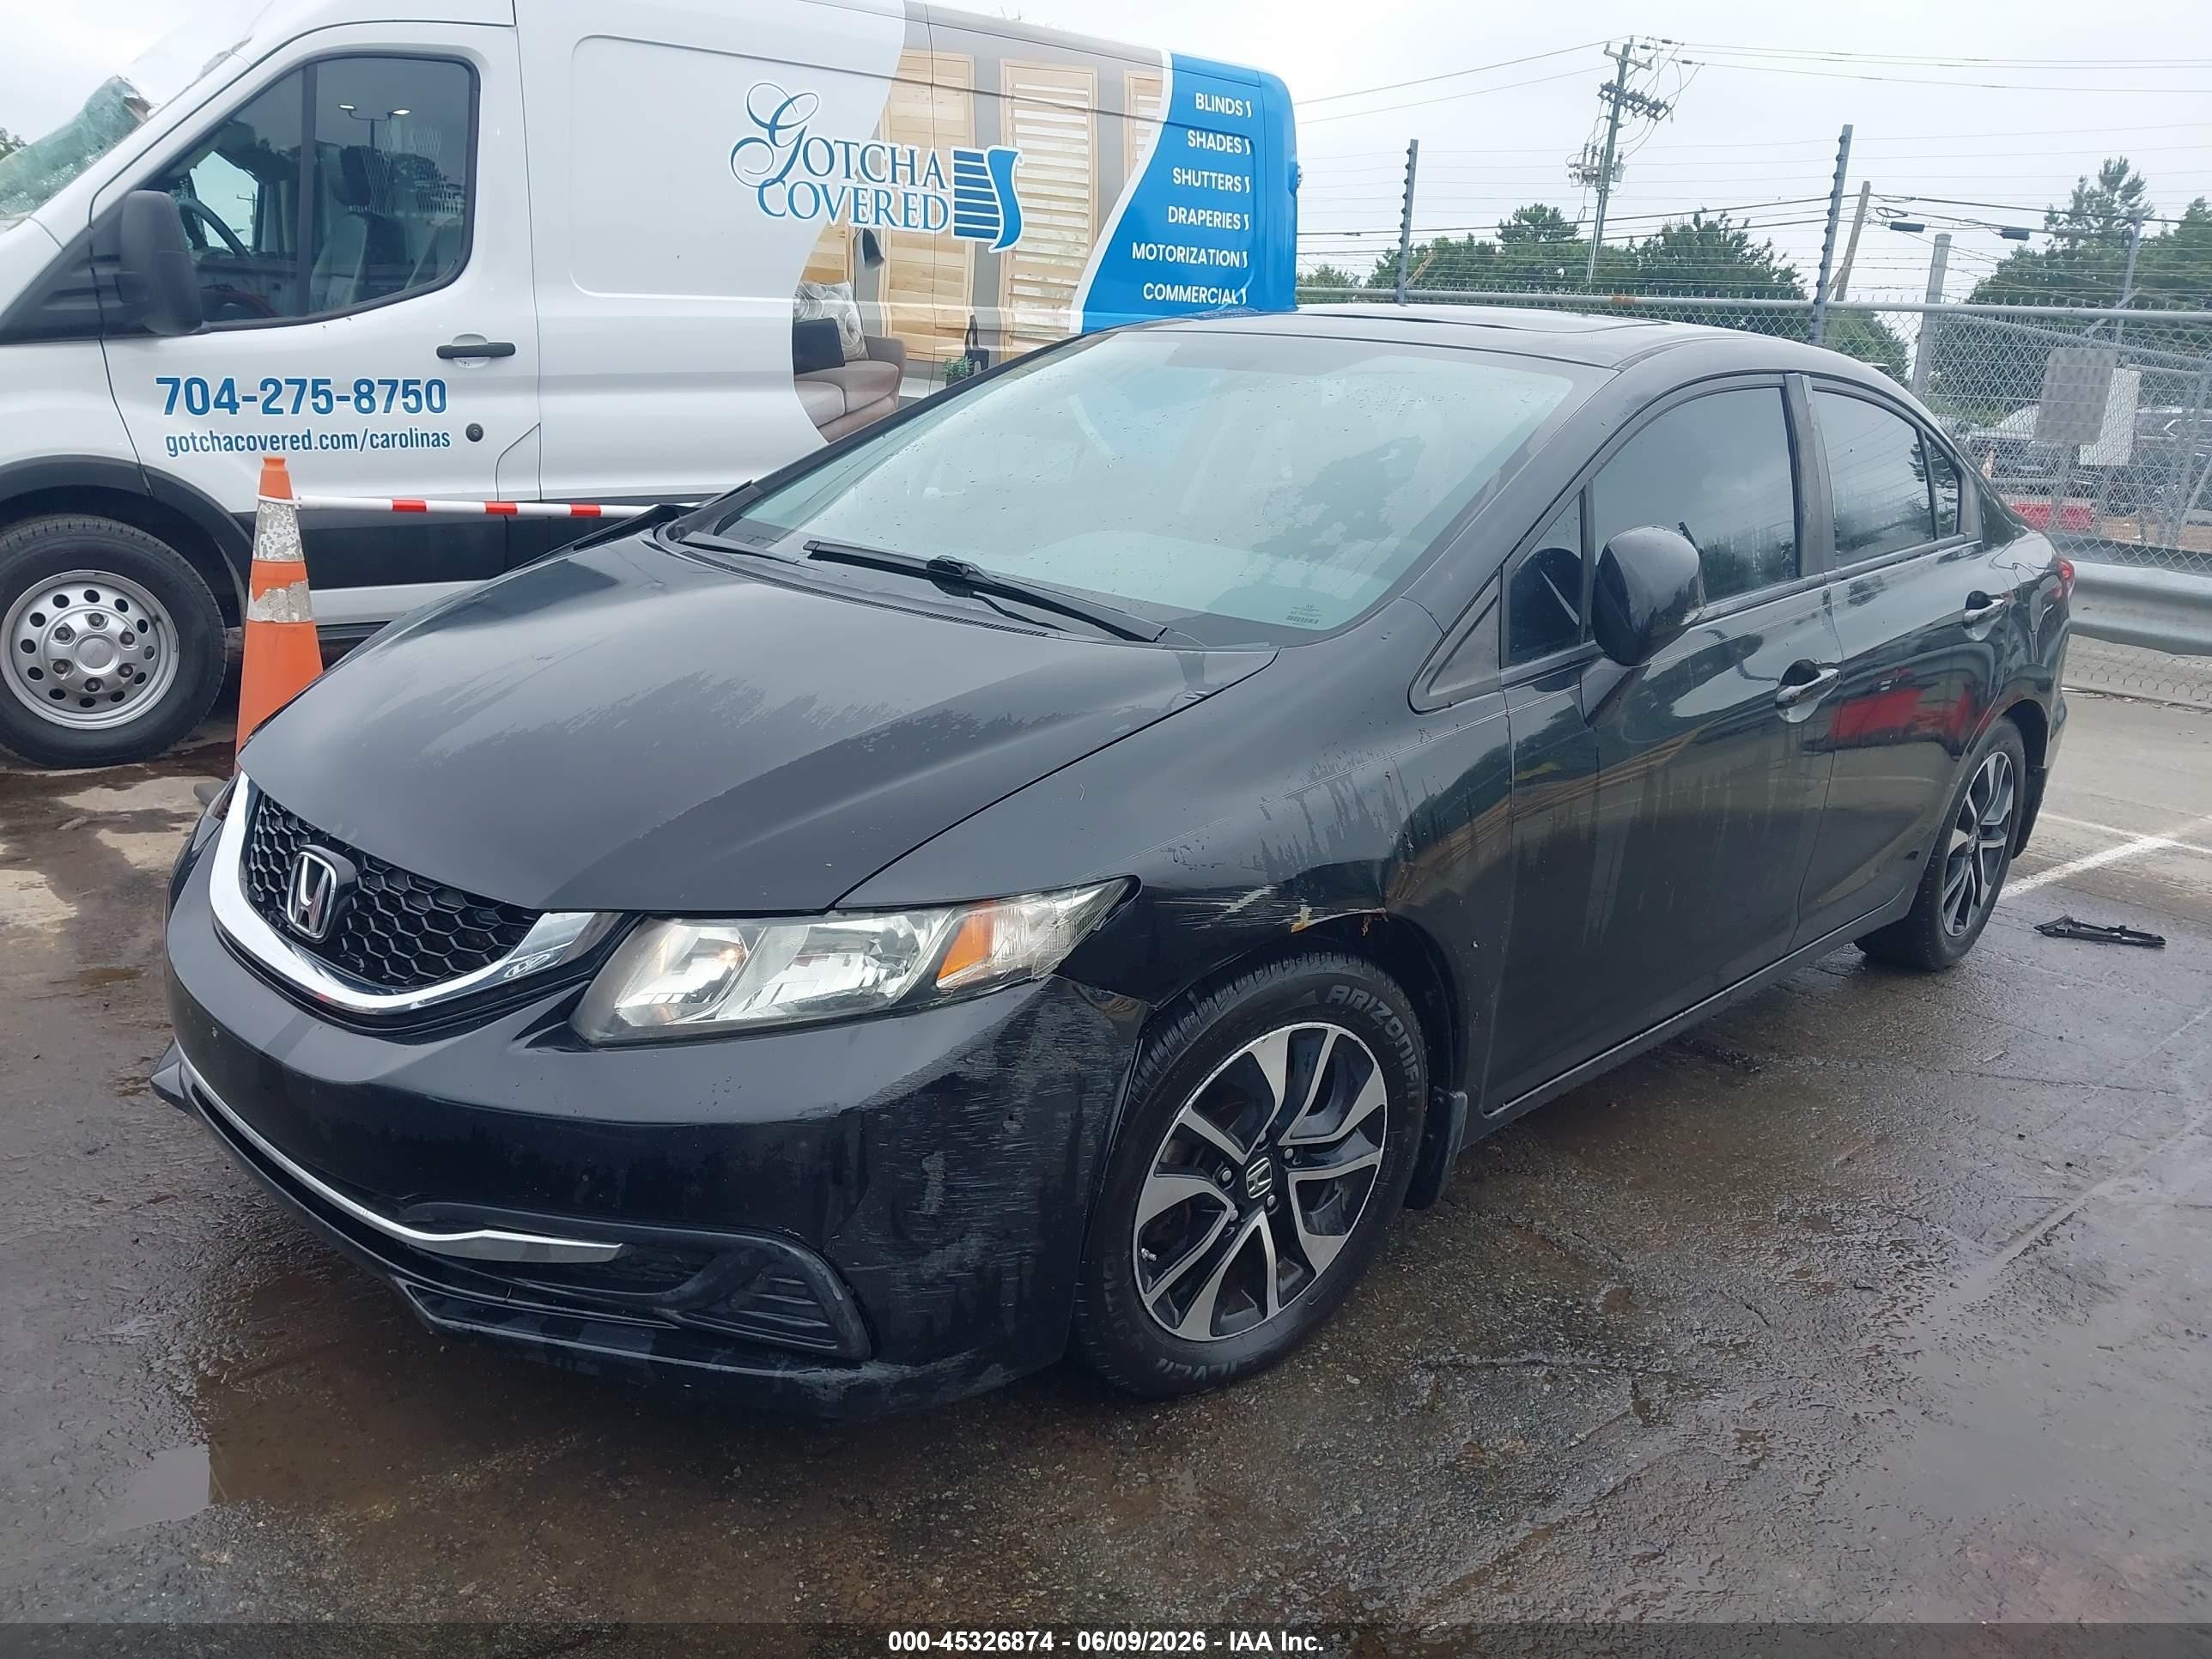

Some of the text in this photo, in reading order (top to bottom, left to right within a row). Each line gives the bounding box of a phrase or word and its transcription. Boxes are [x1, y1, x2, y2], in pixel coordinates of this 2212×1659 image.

[1195, 92, 1243, 117] BLINDS
[1188, 130, 1243, 155] SHADES
[1172, 167, 1242, 193] SHUTTERS
[757, 178, 949, 231] COVERED
[1168, 205, 1241, 230] DRAPERIES
[1132, 241, 1240, 268] MOTORIZATION
[1143, 283, 1239, 306] COMMERCIAL
[155, 377, 447, 416] 704-275-8750
[166, 428, 450, 457] gotchacovered.com/carolinas
